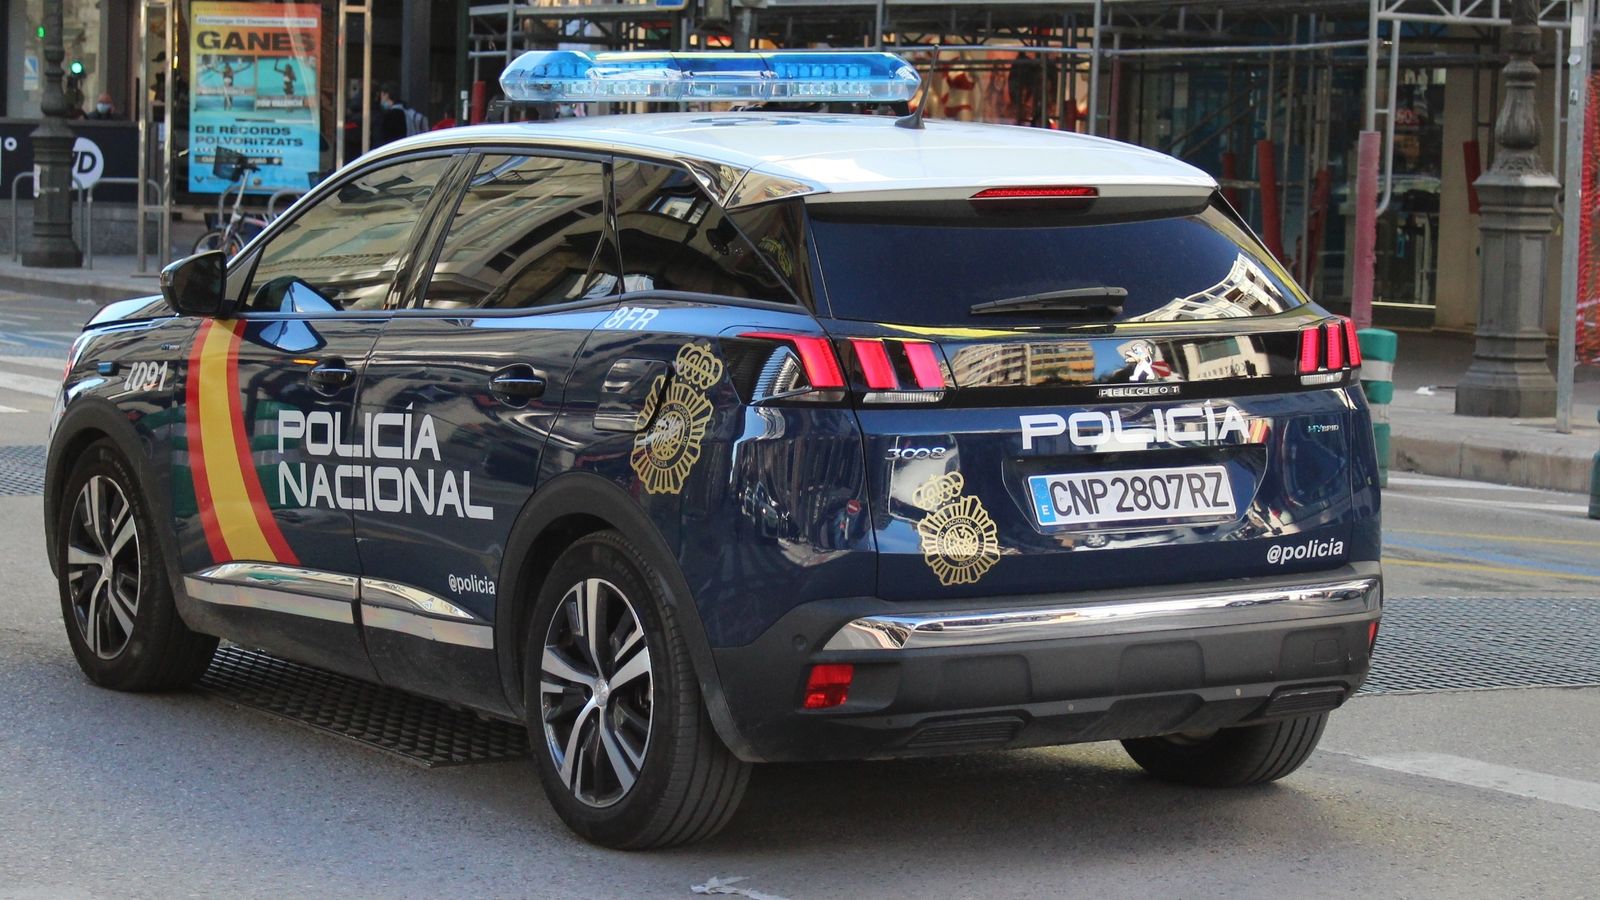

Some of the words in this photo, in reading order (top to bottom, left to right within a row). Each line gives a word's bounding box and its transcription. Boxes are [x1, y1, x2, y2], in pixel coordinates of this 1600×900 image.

[196, 30, 316, 52] GANES
[195, 125, 215, 135] DE
[195, 135, 304, 147] POLVORITZATS
[604, 306, 660, 330] 8FR
[1099, 386, 1179, 398] PEUGEOT
[278, 402, 441, 461] POLICÍA
[1019, 399, 1250, 450] POLICÍA
[884, 446, 947, 461] 3008
[278, 460, 494, 520] NACIONAL
[1041, 504, 1050, 516] E
[1267, 537, 1345, 566] @policia
[448, 573, 496, 595] @policia
